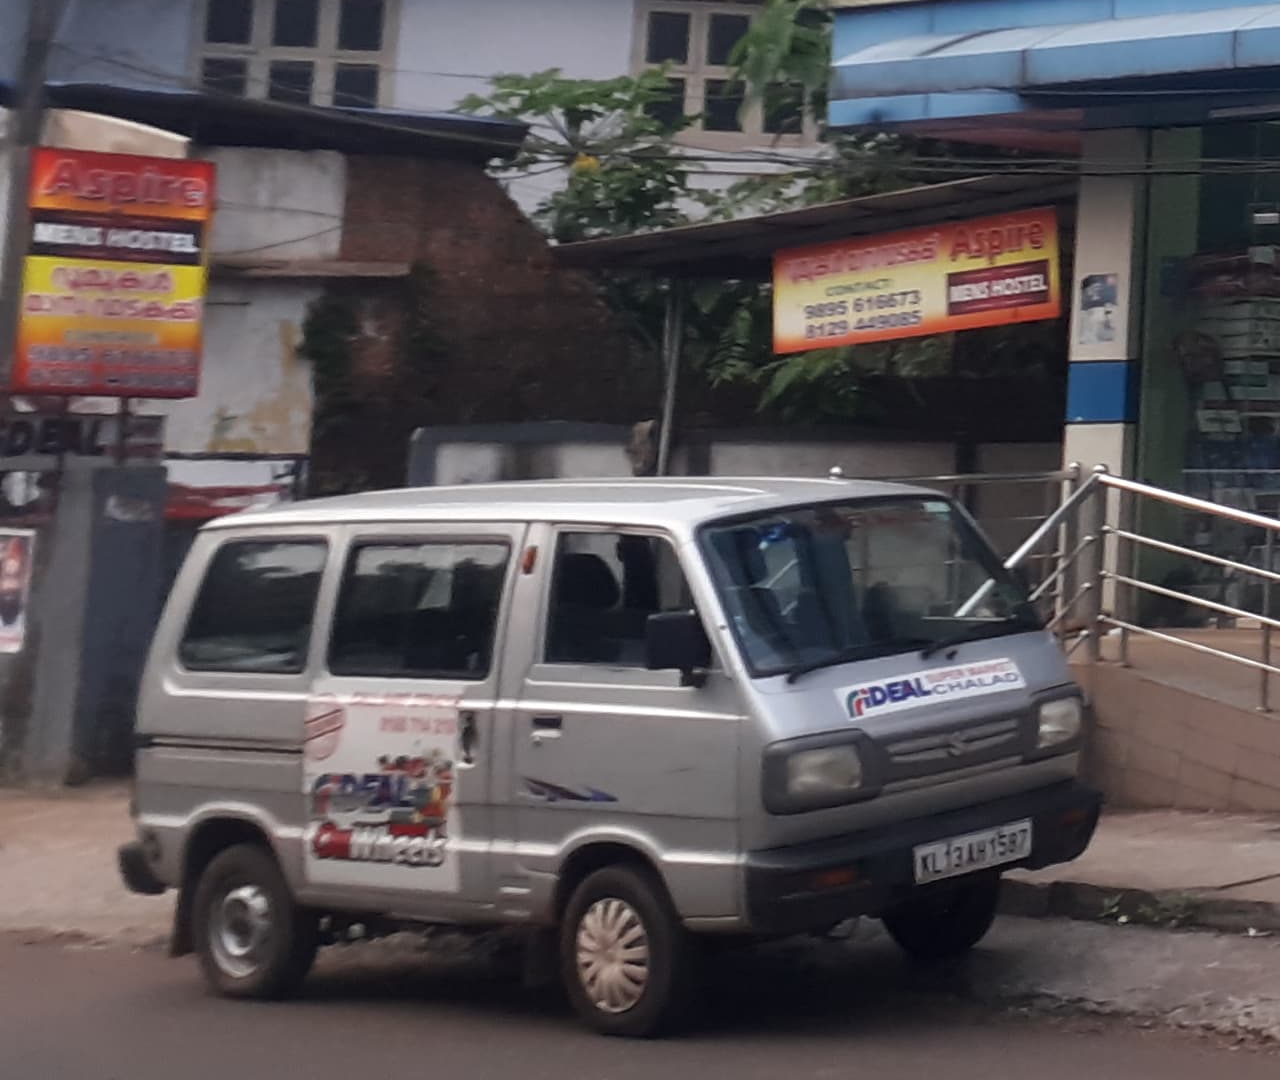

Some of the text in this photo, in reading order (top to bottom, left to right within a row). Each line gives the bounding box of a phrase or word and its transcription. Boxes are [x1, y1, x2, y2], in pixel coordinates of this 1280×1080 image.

[42, 159, 207, 210] Aspire
[950, 221, 1044, 265] Aspire
[991, 273, 1048, 297] HOSTEL
[931, 672, 1019, 696] CHALAD
